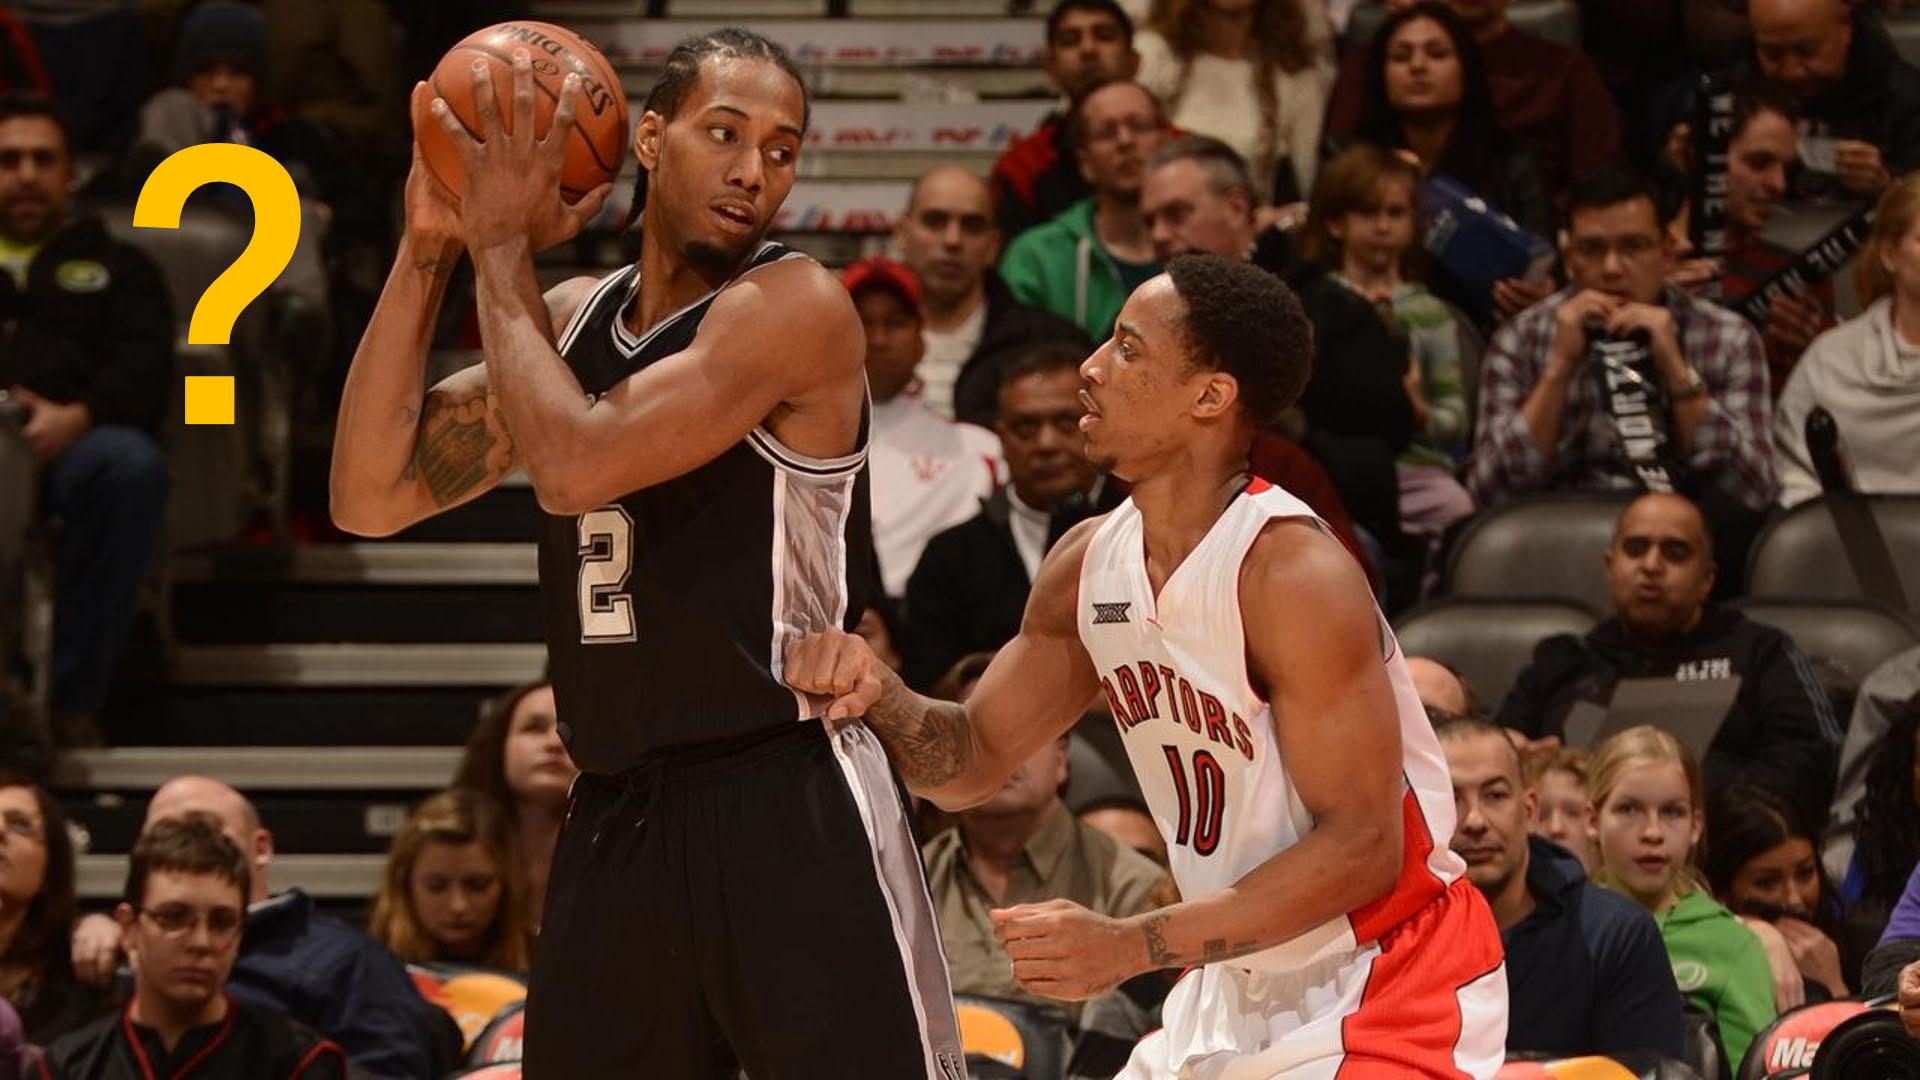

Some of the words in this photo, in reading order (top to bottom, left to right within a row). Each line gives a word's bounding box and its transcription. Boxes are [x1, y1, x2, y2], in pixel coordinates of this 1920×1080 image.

[498, 24, 614, 117] SPDING
[578, 504, 638, 644] 2
[1101, 660, 1255, 762] RAPTORS
[1162, 744, 1225, 857] 10
